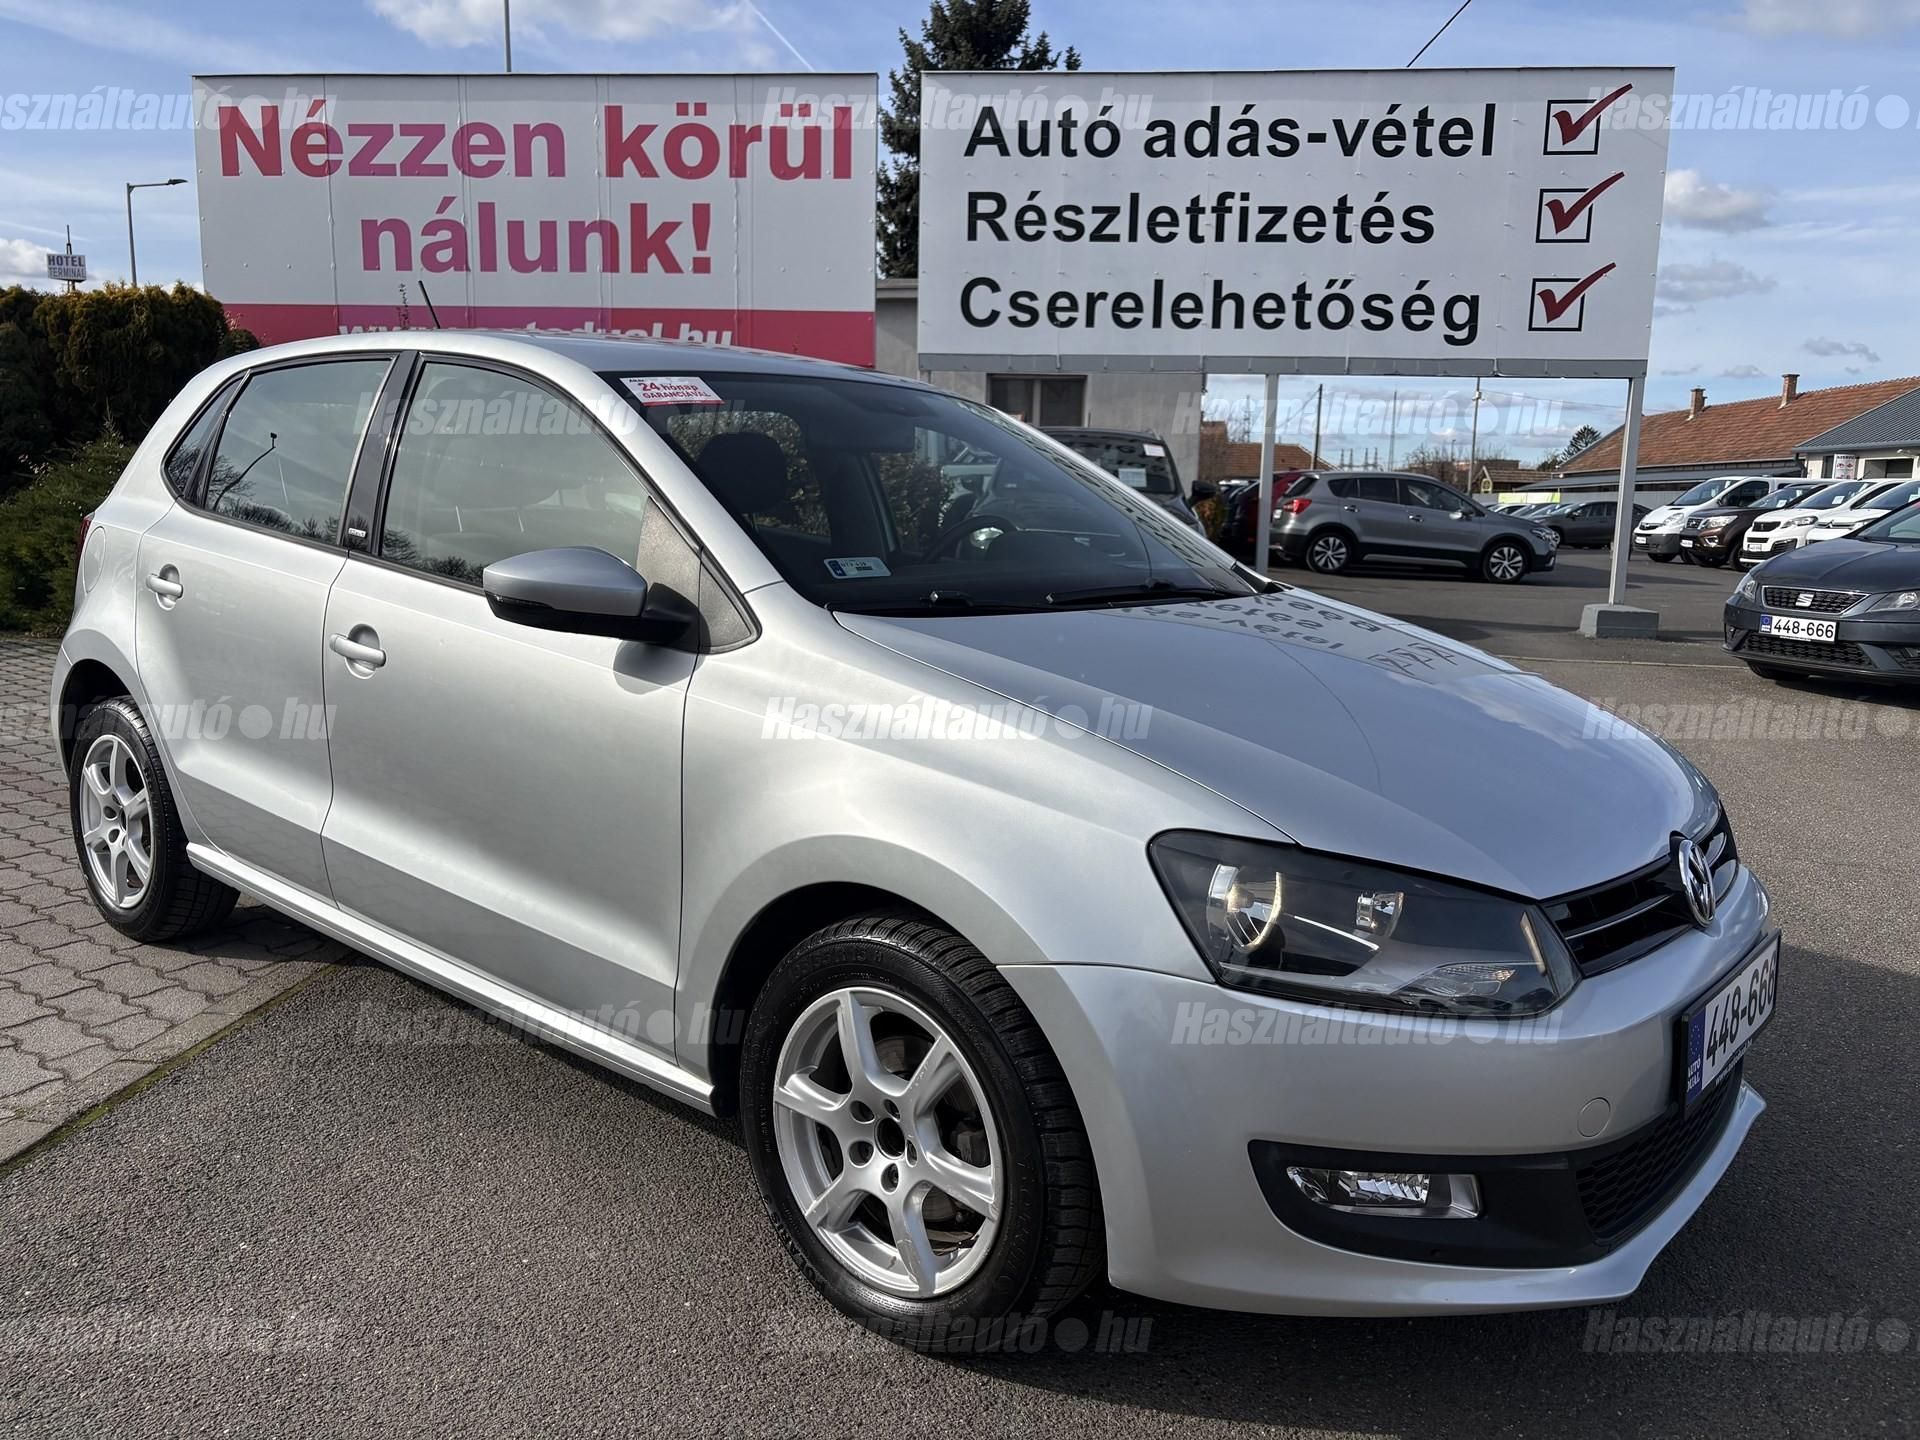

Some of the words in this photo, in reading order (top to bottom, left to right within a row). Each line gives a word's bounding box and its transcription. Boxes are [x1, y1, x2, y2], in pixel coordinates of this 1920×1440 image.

[219, 99, 565, 178] Nézzen
[605, 102, 853, 181] körül
[963, 105, 1121, 158] Autó
[1143, 103, 1496, 159] adás-vétel
[361, 196, 712, 275] nálunk!
[967, 190, 1435, 244] Részletfizetés
[48, 255, 85, 267] HOTEL
[960, 276, 1480, 347] Cserelehetőség
[638, 382, 660, 392] 24
[1773, 619, 1835, 639] 448-666
[1705, 951, 1777, 1067] 448-666
